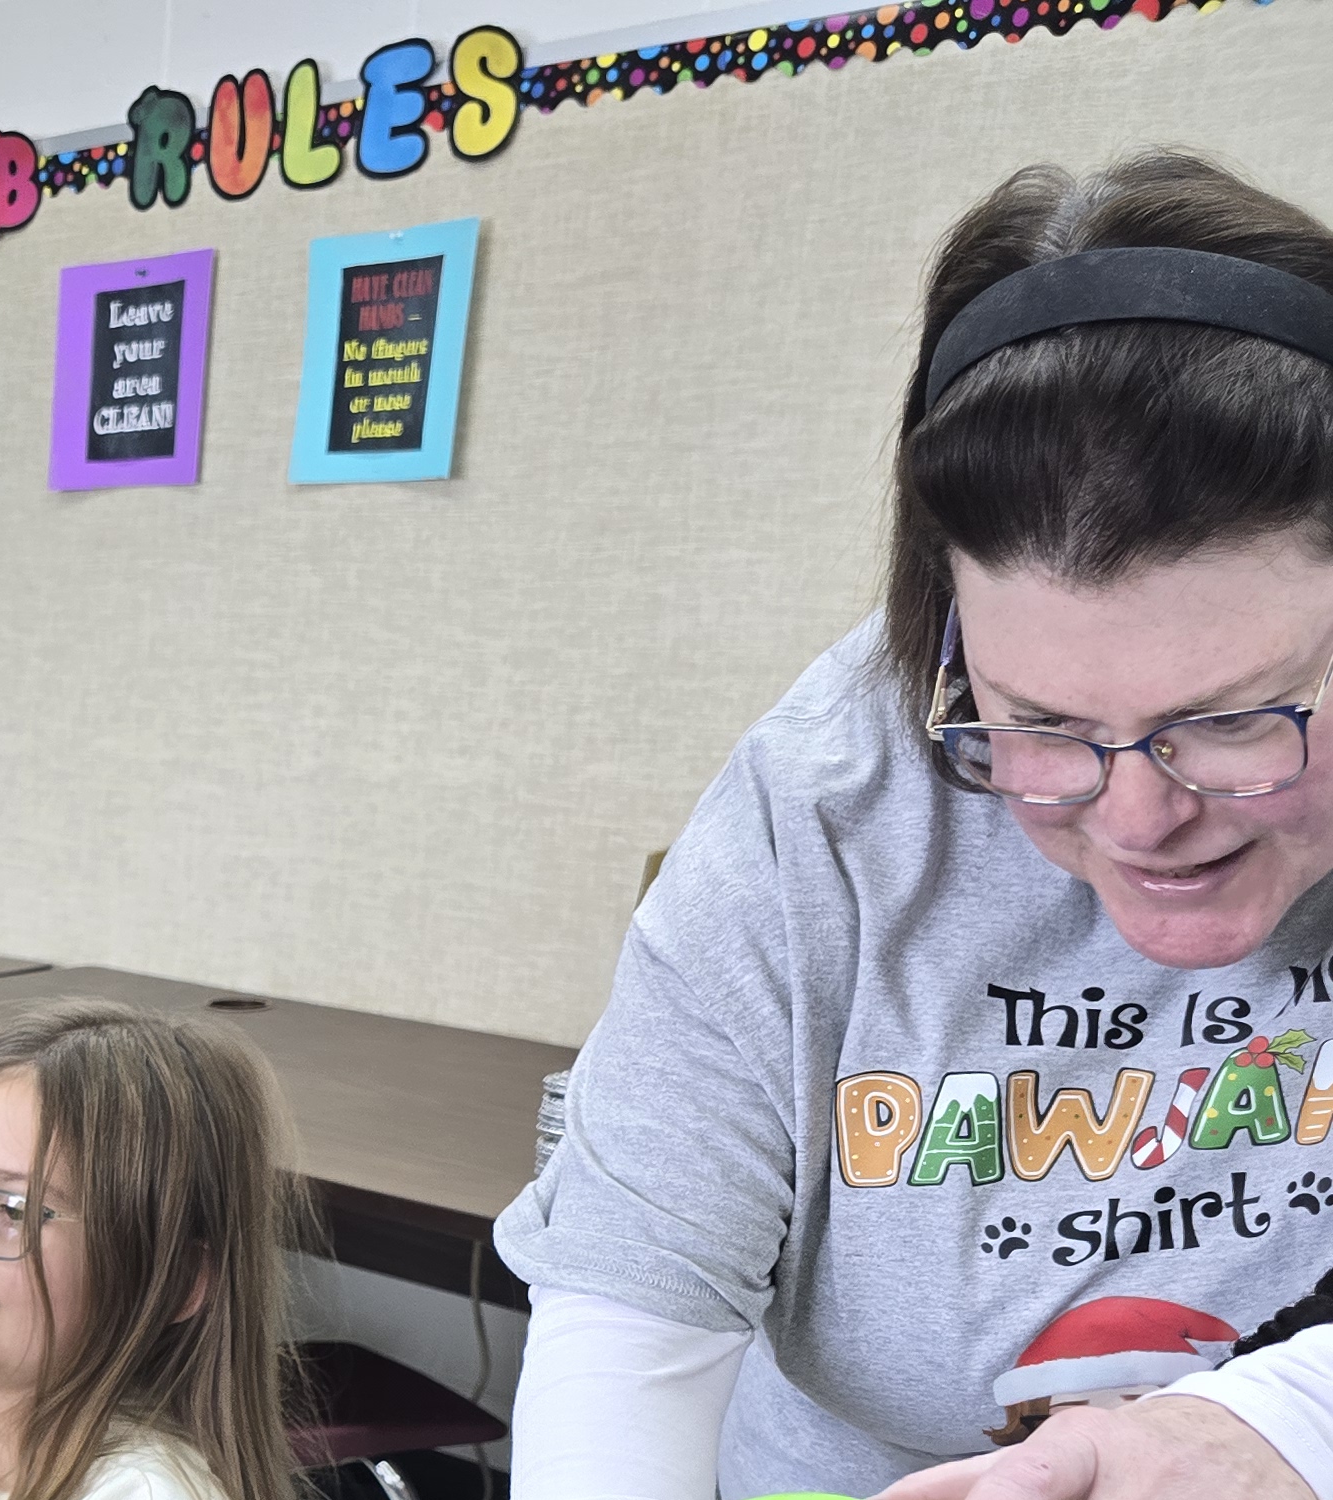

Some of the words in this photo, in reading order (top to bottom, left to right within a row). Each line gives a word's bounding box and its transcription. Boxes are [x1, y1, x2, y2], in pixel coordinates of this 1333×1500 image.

[128, 25, 523, 210] RULES
[109, 300, 174, 328] Leave
[113, 337, 166, 369] your
[343, 338, 368, 362] No
[113, 373, 162, 399] area
[987, 983, 1148, 1049] This
[1052, 1172, 1271, 1266] shirt
